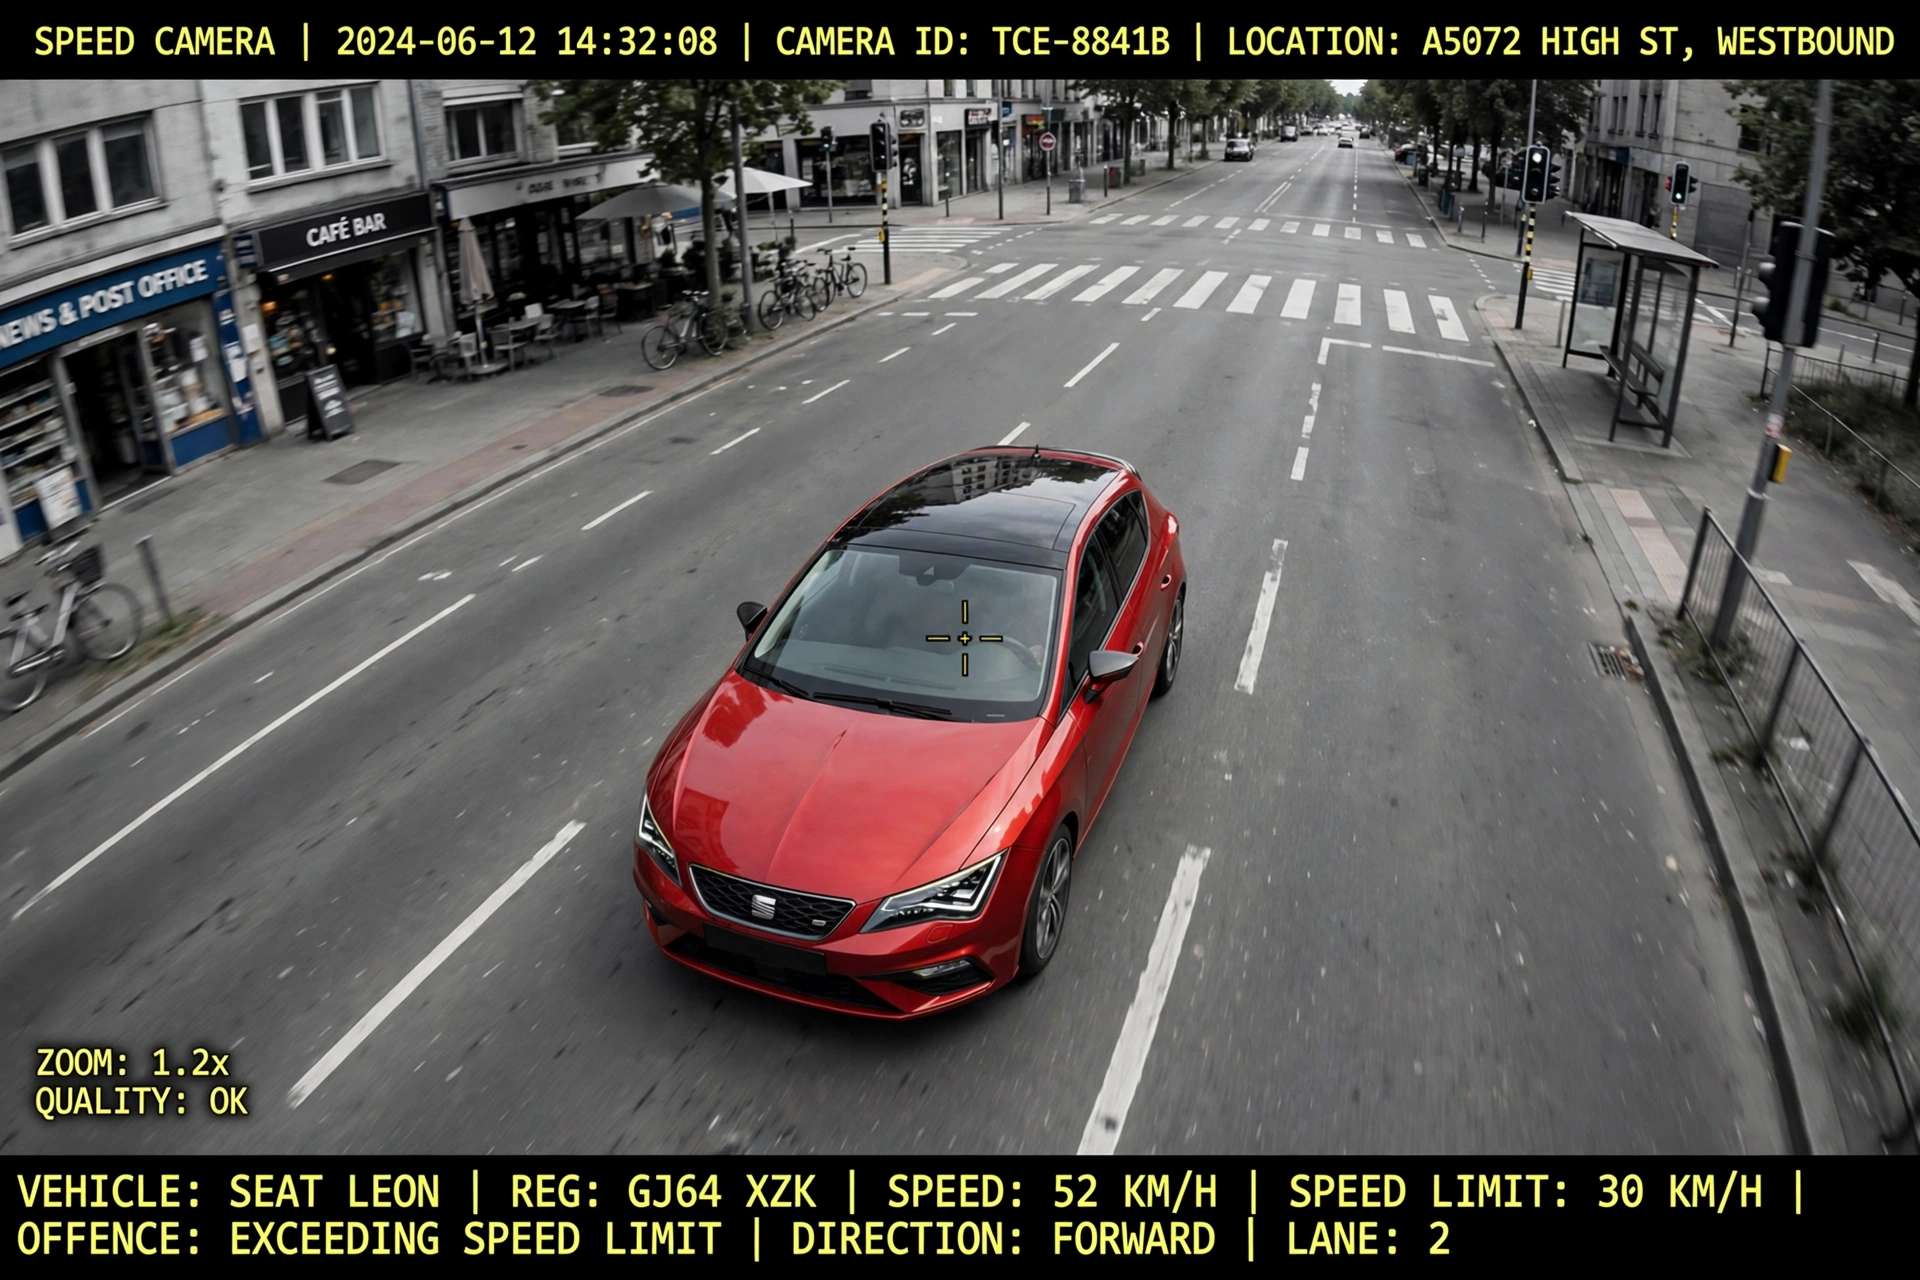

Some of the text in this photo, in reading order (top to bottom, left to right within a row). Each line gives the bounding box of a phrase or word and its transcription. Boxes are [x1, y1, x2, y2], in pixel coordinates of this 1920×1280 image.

[306, 213, 387, 247] CAFÉ BAR
[58, 301, 79, 326] &
[78, 280, 135, 319] POST
[137, 259, 209, 298] OFFICE
